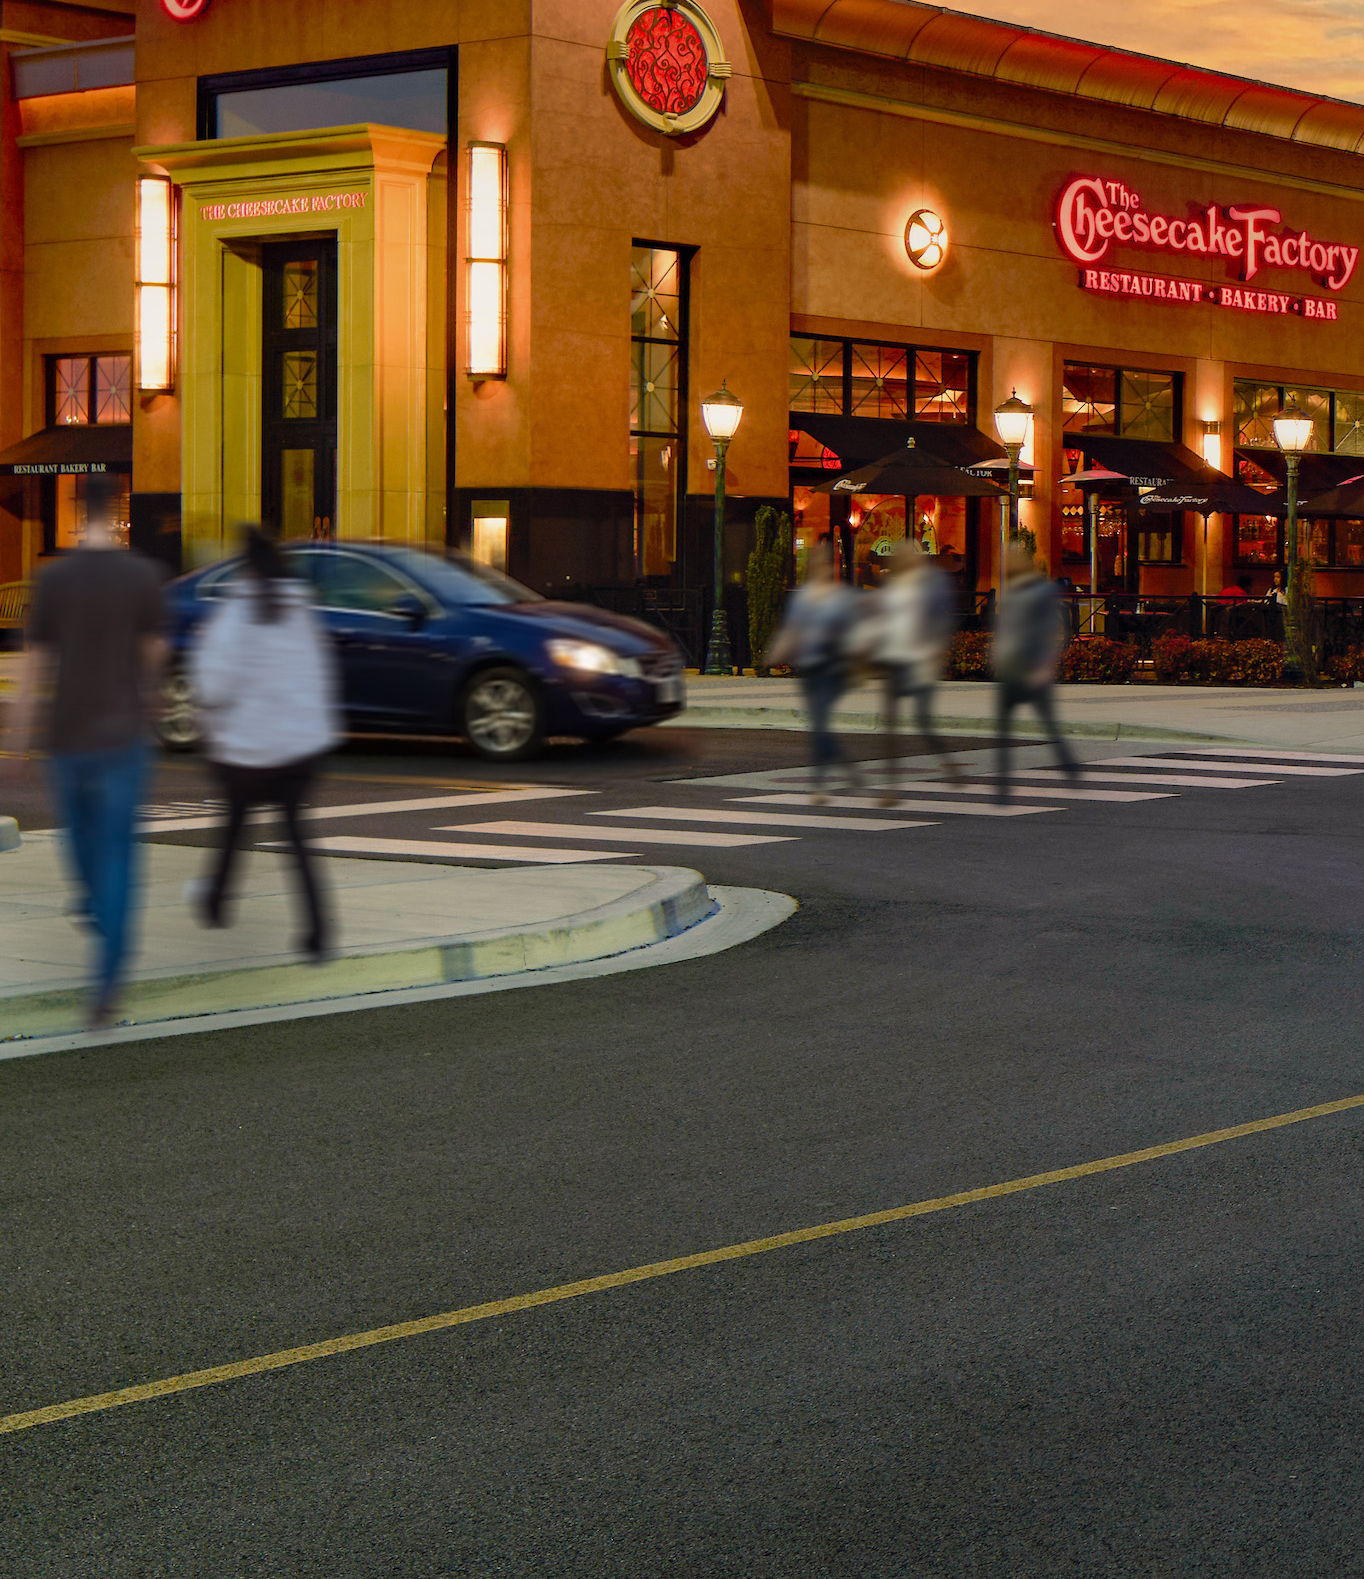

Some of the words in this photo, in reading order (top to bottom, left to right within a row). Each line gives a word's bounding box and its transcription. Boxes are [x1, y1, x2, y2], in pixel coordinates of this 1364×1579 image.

[200, 204, 225, 221] THE
[226, 197, 309, 219] CHEESECAKE
[311, 192, 368, 212] FACTORY
[1106, 181, 1140, 212] The
[1059, 177, 1244, 262] Cheesecake
[1229, 206, 1359, 291] Factory
[1084, 269, 1203, 303] RESTAURANT
[1220, 287, 1290, 314] BAKERY
[1304, 298, 1338, 320] BAR
[13, 464, 58, 475] RESTAURANT
[60, 463, 89, 474] BAKERY
[91, 463, 107, 473] BAR
